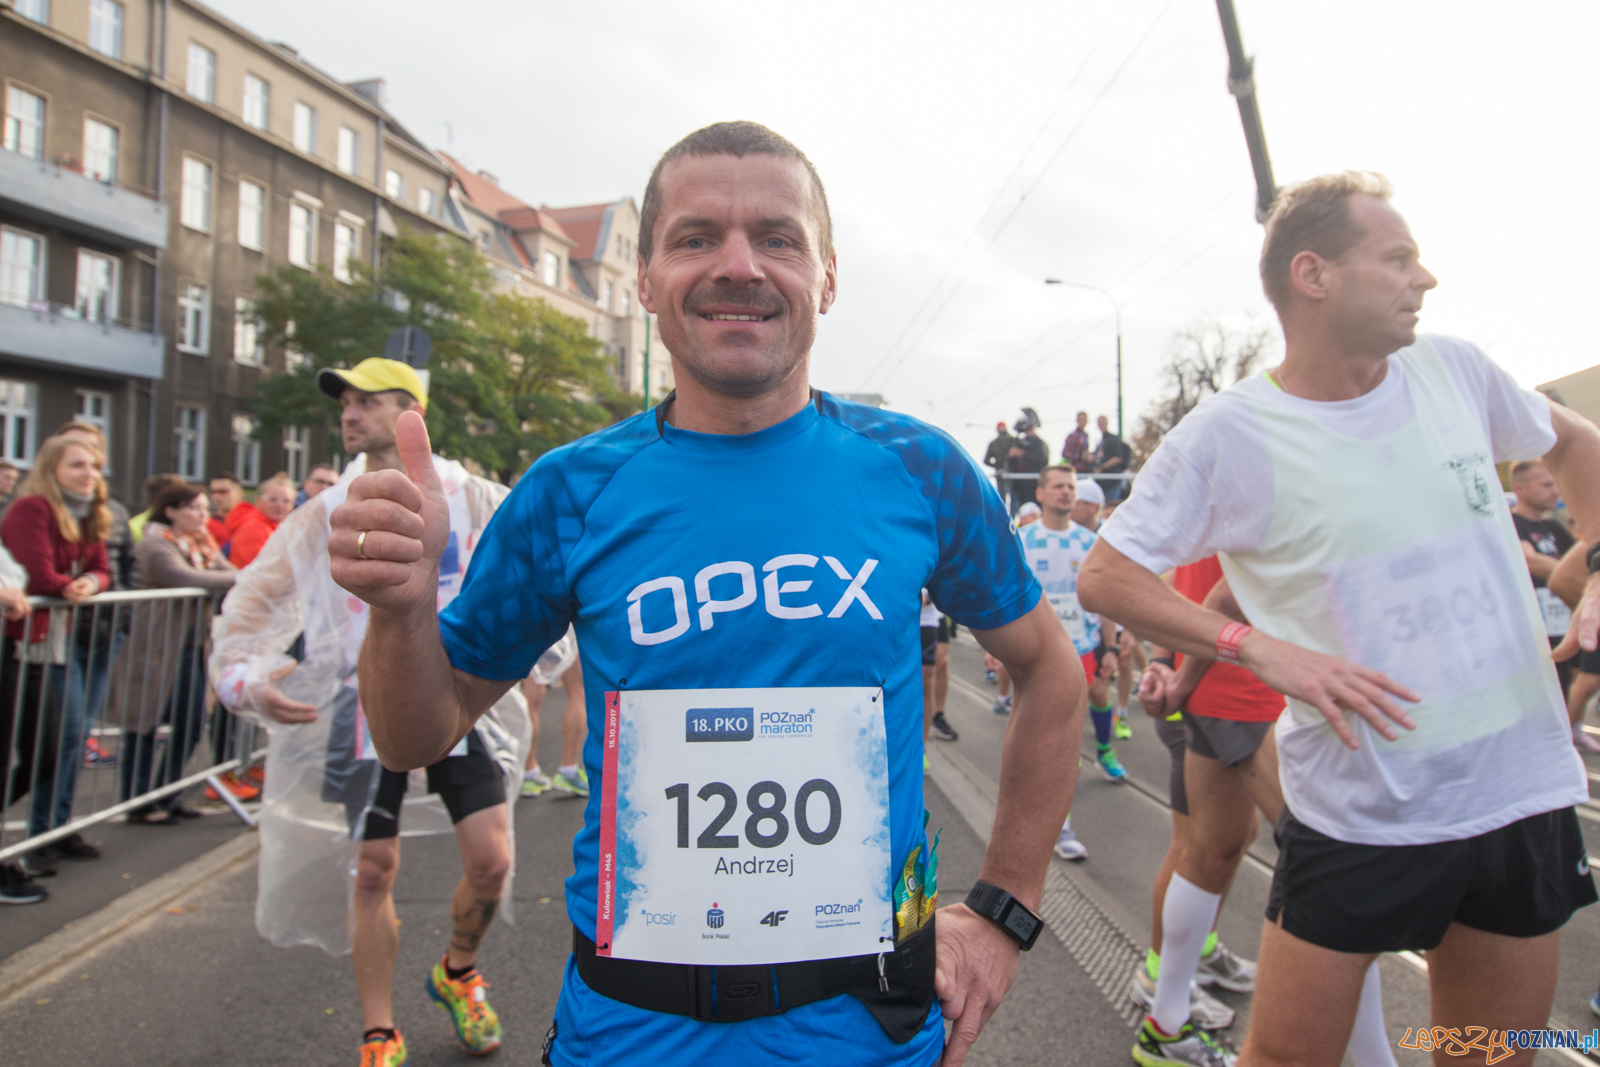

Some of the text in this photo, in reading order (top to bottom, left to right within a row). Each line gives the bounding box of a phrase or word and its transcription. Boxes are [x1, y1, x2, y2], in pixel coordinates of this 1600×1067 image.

[626, 553, 884, 646] OPEX
[608, 709, 616, 748] 15.10.2017
[692, 717, 748, 732] 18. PKO
[760, 722, 813, 734] maraton
[664, 778, 842, 849] 1280
[714, 854, 794, 877] Andrzej
[603, 880, 611, 919] Kulawiak
[646, 911, 677, 926] posir
[760, 910, 789, 927] 4F
